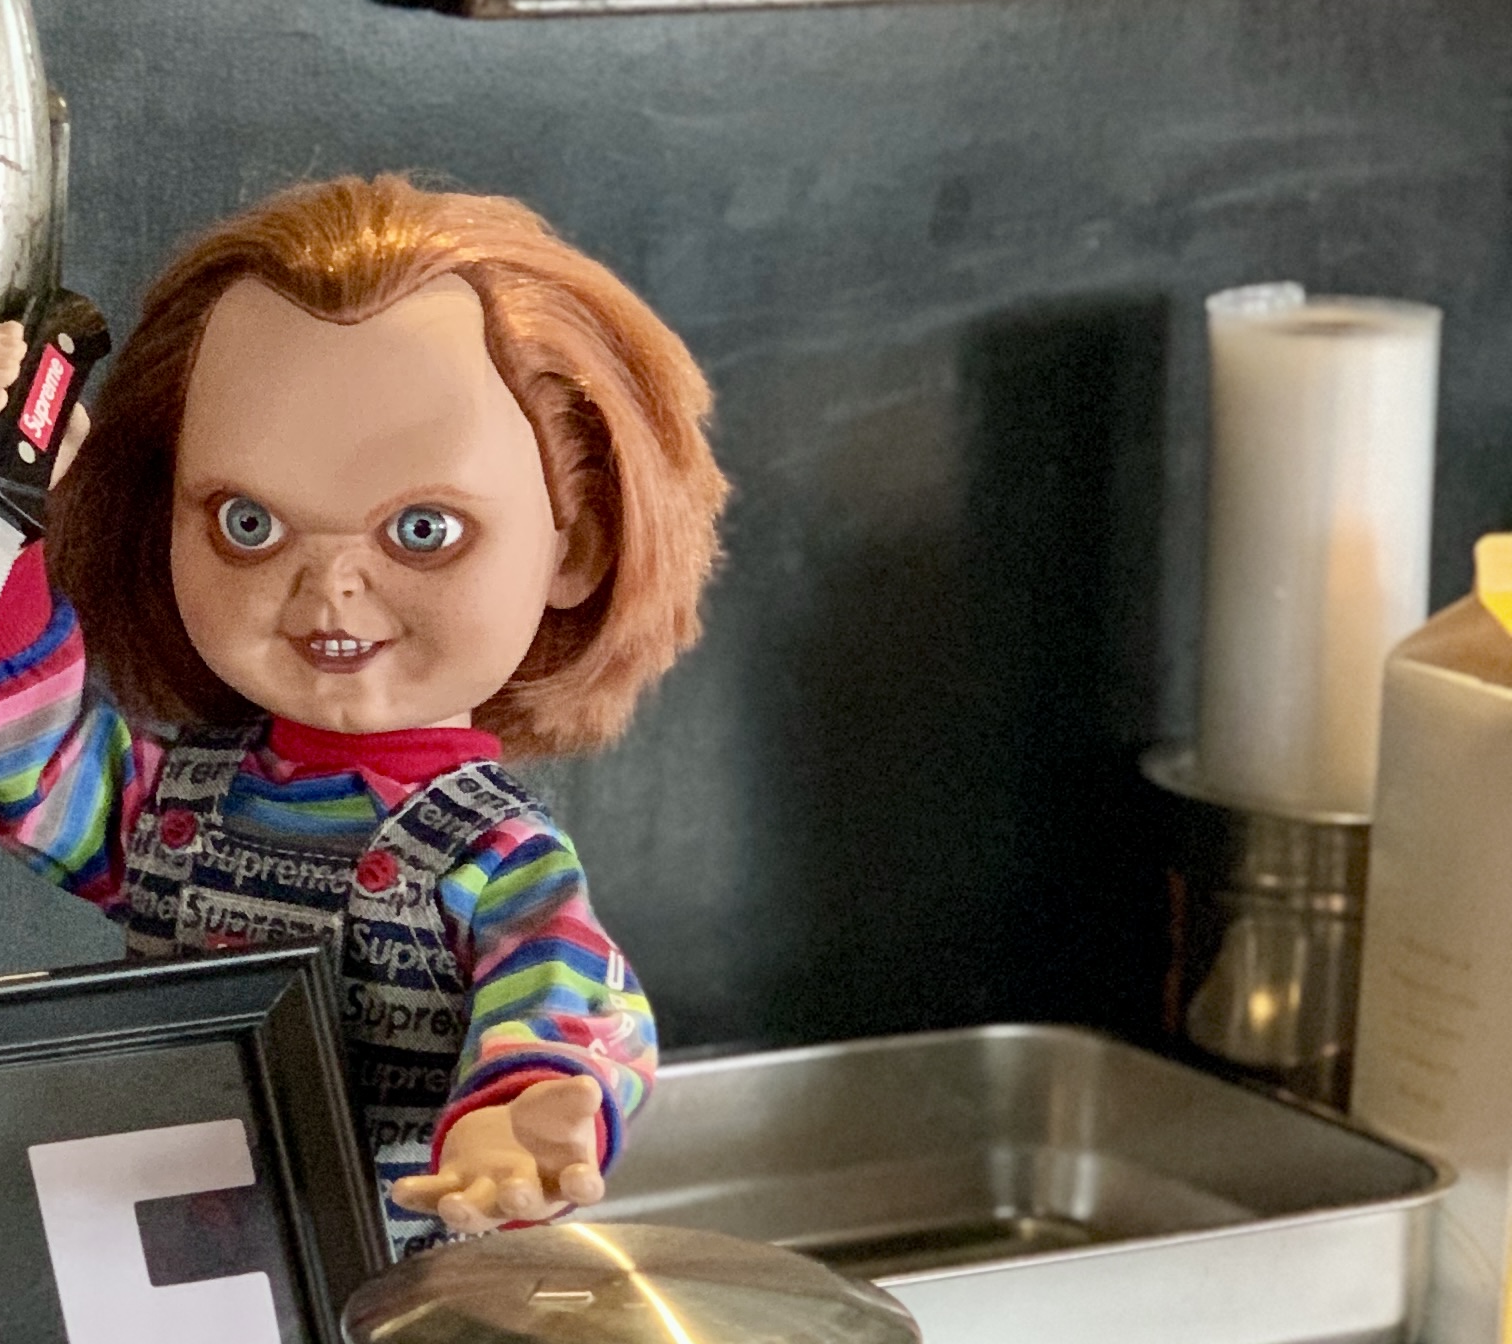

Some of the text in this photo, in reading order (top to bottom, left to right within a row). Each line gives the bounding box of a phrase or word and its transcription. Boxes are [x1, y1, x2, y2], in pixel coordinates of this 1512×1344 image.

[23, 357, 65, 439] Supreme
[199, 830, 349, 896] Supreme
[349, 922, 460, 981] Supre
